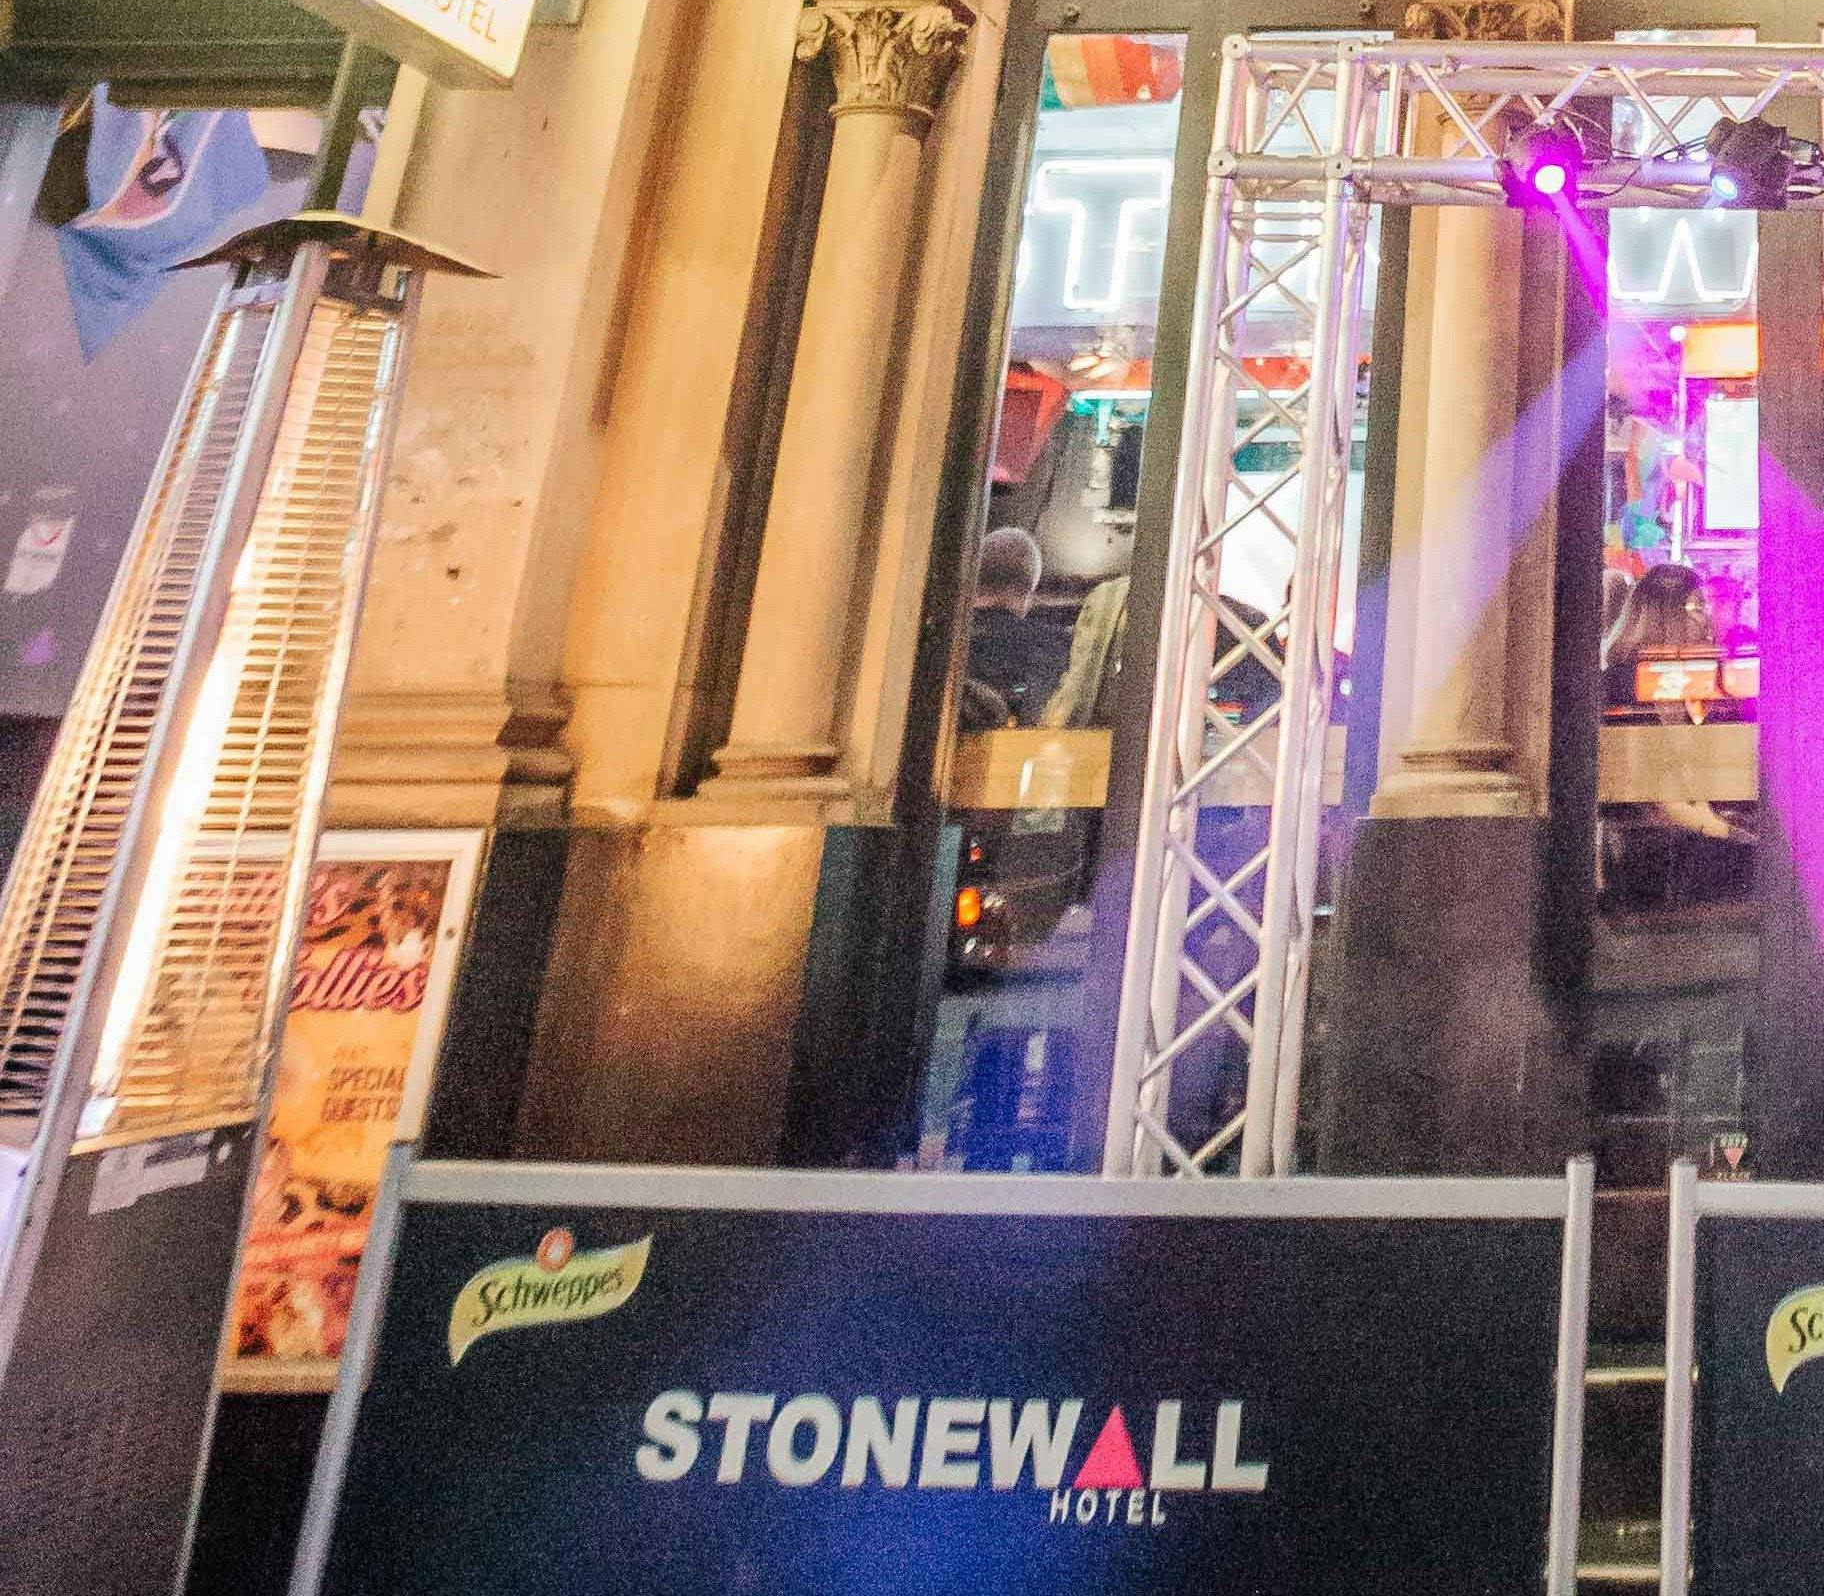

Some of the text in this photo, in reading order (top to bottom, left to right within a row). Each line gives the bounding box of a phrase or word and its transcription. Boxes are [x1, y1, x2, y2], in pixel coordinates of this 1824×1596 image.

[288, 944, 428, 1015] ollies
[472, 1266, 626, 1329] Schweppes
[1049, 1488, 1167, 1525] HOTEL
